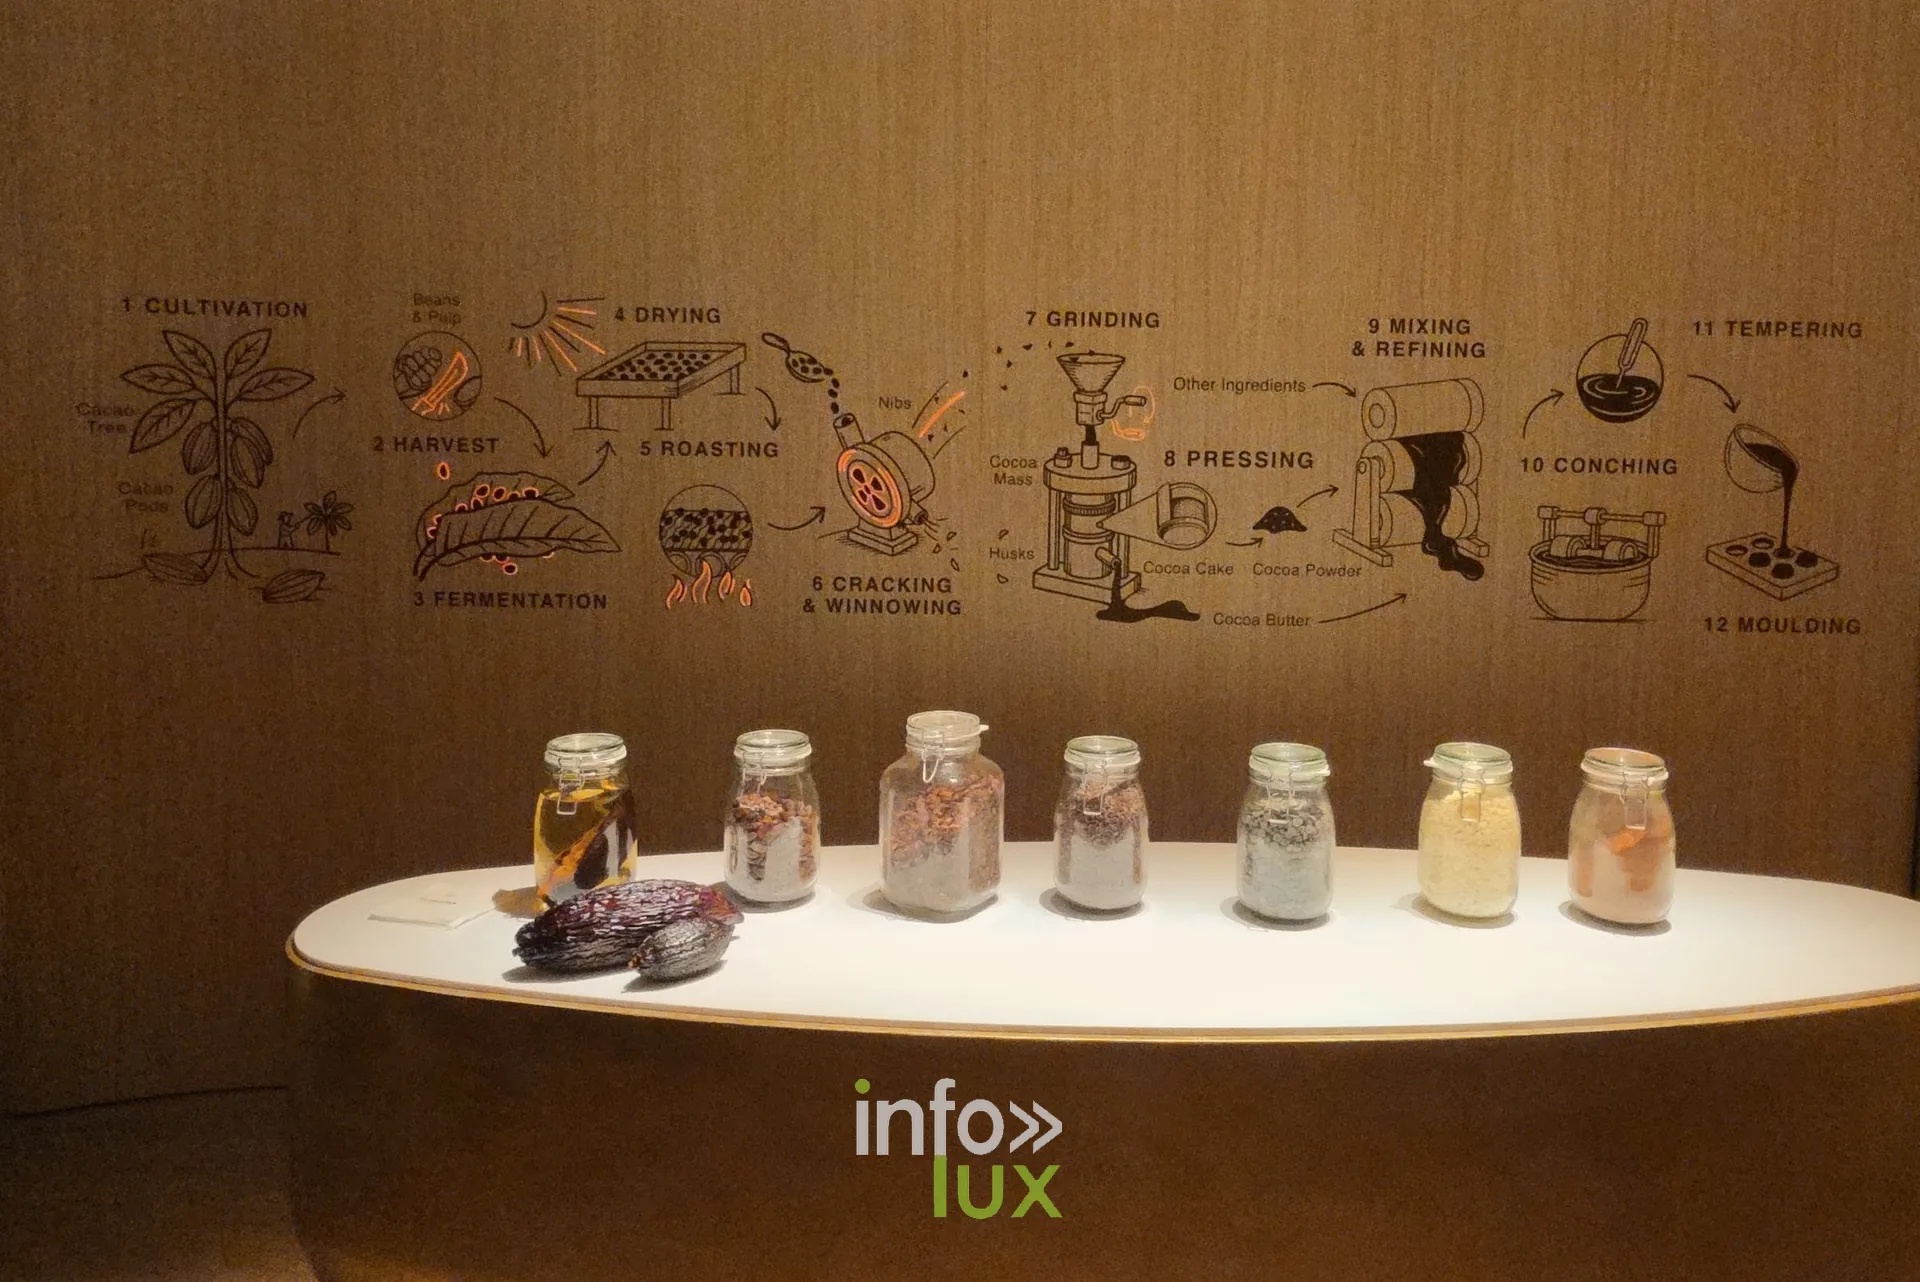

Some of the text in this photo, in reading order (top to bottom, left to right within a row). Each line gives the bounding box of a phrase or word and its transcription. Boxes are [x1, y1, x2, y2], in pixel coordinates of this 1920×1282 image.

[123, 297, 308, 319] 1 CULTIVATION
[413, 293, 461, 308] Beans
[412, 311, 462, 326] & Pulp
[614, 308, 722, 324] 4 DRYING
[1025, 311, 1160, 329] 7 GRINDING
[1368, 318, 1471, 335] 9 MIXING
[1692, 321, 1862, 339] 11 TEMPERING
[1352, 341, 1486, 359] & REFINING
[1173, 376, 1306, 395] Other Ingredients
[76, 402, 134, 417] Cacao
[879, 396, 912, 410] Nibs
[88, 421, 126, 433] Tree
[373, 437, 499, 454] 2 HARVEST
[640, 441, 779, 458] 5 ROASTING
[989, 455, 1038, 470] Cocoa
[1165, 451, 1314, 469] 8 PRESSING
[1520, 457, 1678, 476] 10 CONCHING
[993, 472, 1033, 486] Mass
[117, 481, 173, 496] Cacao
[125, 499, 168, 513] Pods
[990, 547, 1035, 561] Husks
[1143, 561, 1234, 577] Cocoa Cake
[1252, 563, 1363, 579] Cocoa Powder
[813, 576, 952, 593] 6 CRACKING
[413, 591, 607, 609] 3 FERMENTATION
[803, 598, 962, 616] & WINNOWING
[1213, 612, 1311, 627] Cocoa Butter
[1704, 617, 1862, 635] 12 MOULDING
